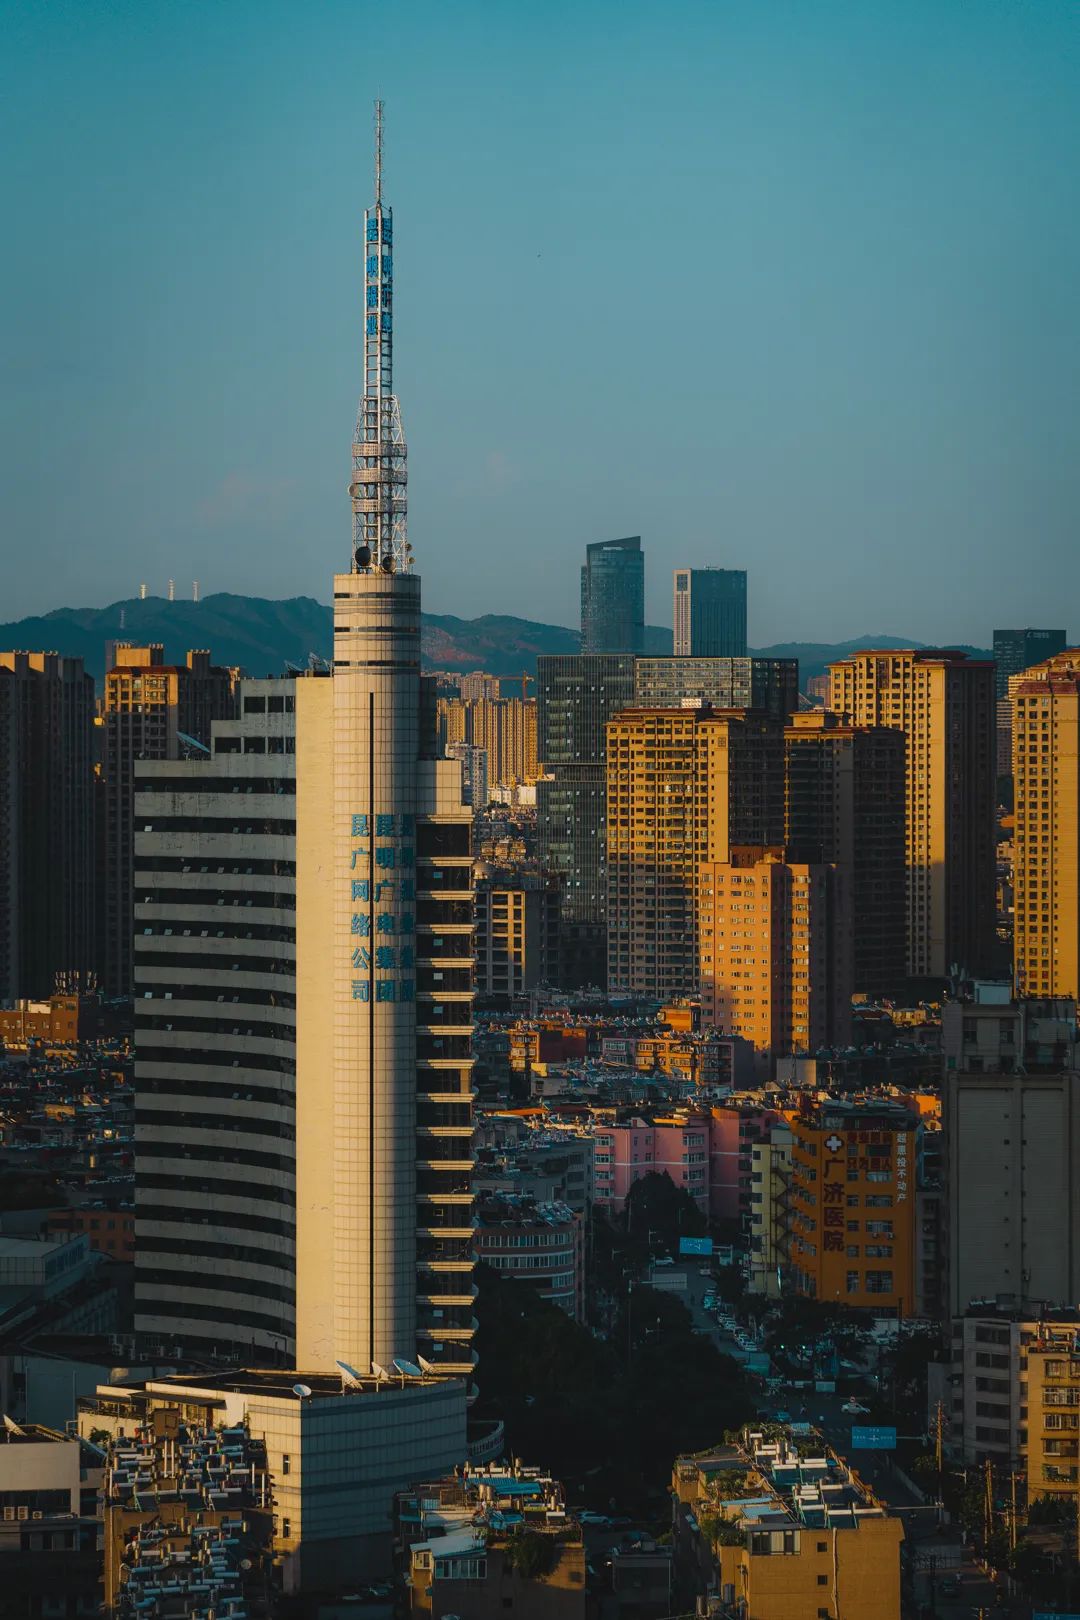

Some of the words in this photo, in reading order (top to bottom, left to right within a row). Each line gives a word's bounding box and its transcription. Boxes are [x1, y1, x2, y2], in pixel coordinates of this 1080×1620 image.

[351, 814, 370, 1002] 昆广网络公司
[375, 814, 395, 1002] 昆明广电集团
[823, 1157, 845, 1252] 广济医院
